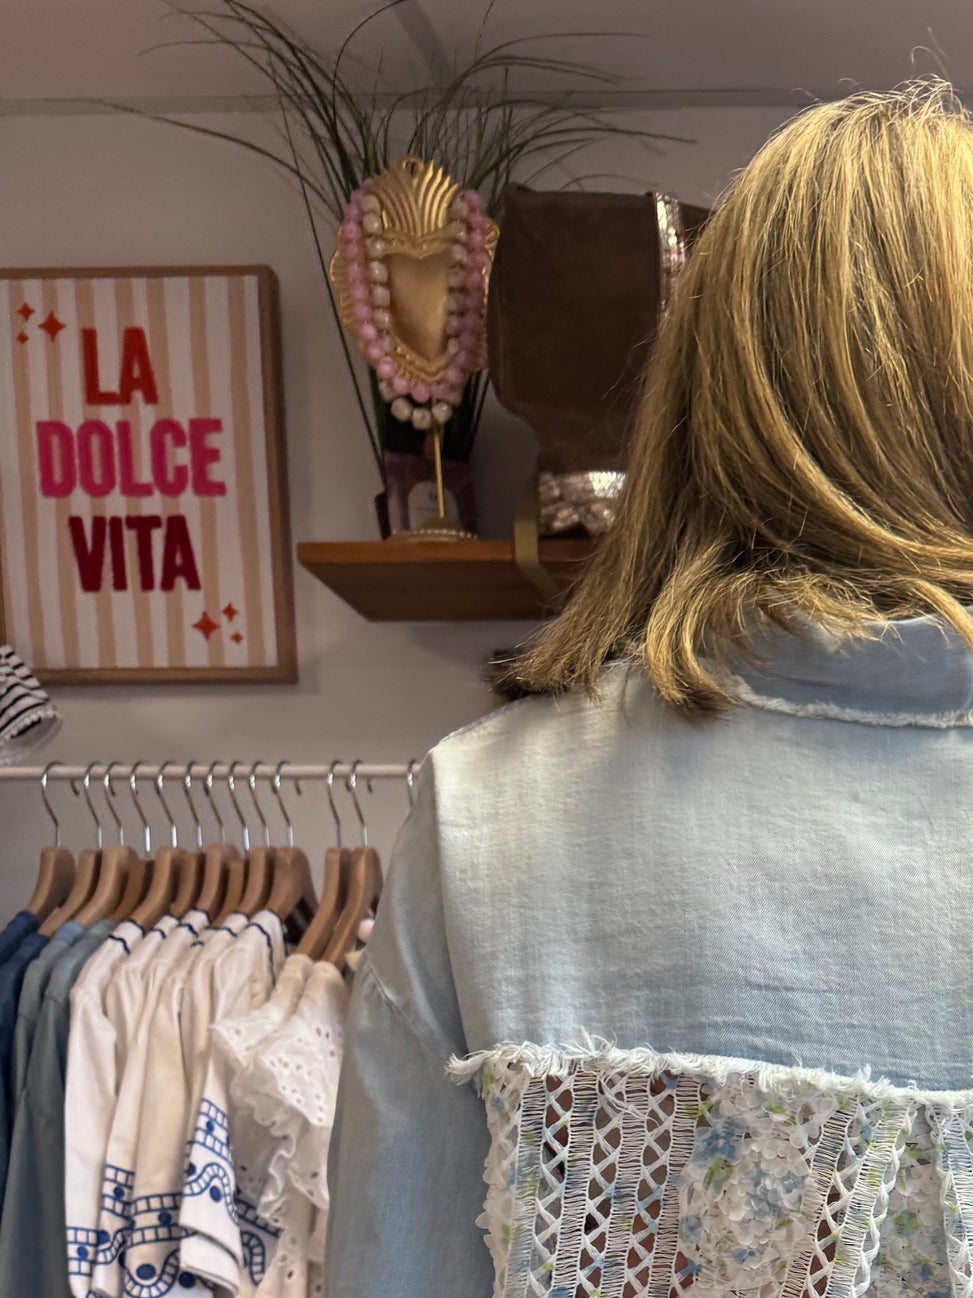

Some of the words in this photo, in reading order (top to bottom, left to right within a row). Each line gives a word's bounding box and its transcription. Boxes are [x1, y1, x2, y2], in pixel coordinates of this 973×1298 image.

[82, 327, 158, 405] LA
[36, 418, 227, 497] DOLCE
[68, 515, 201, 592] VITA
